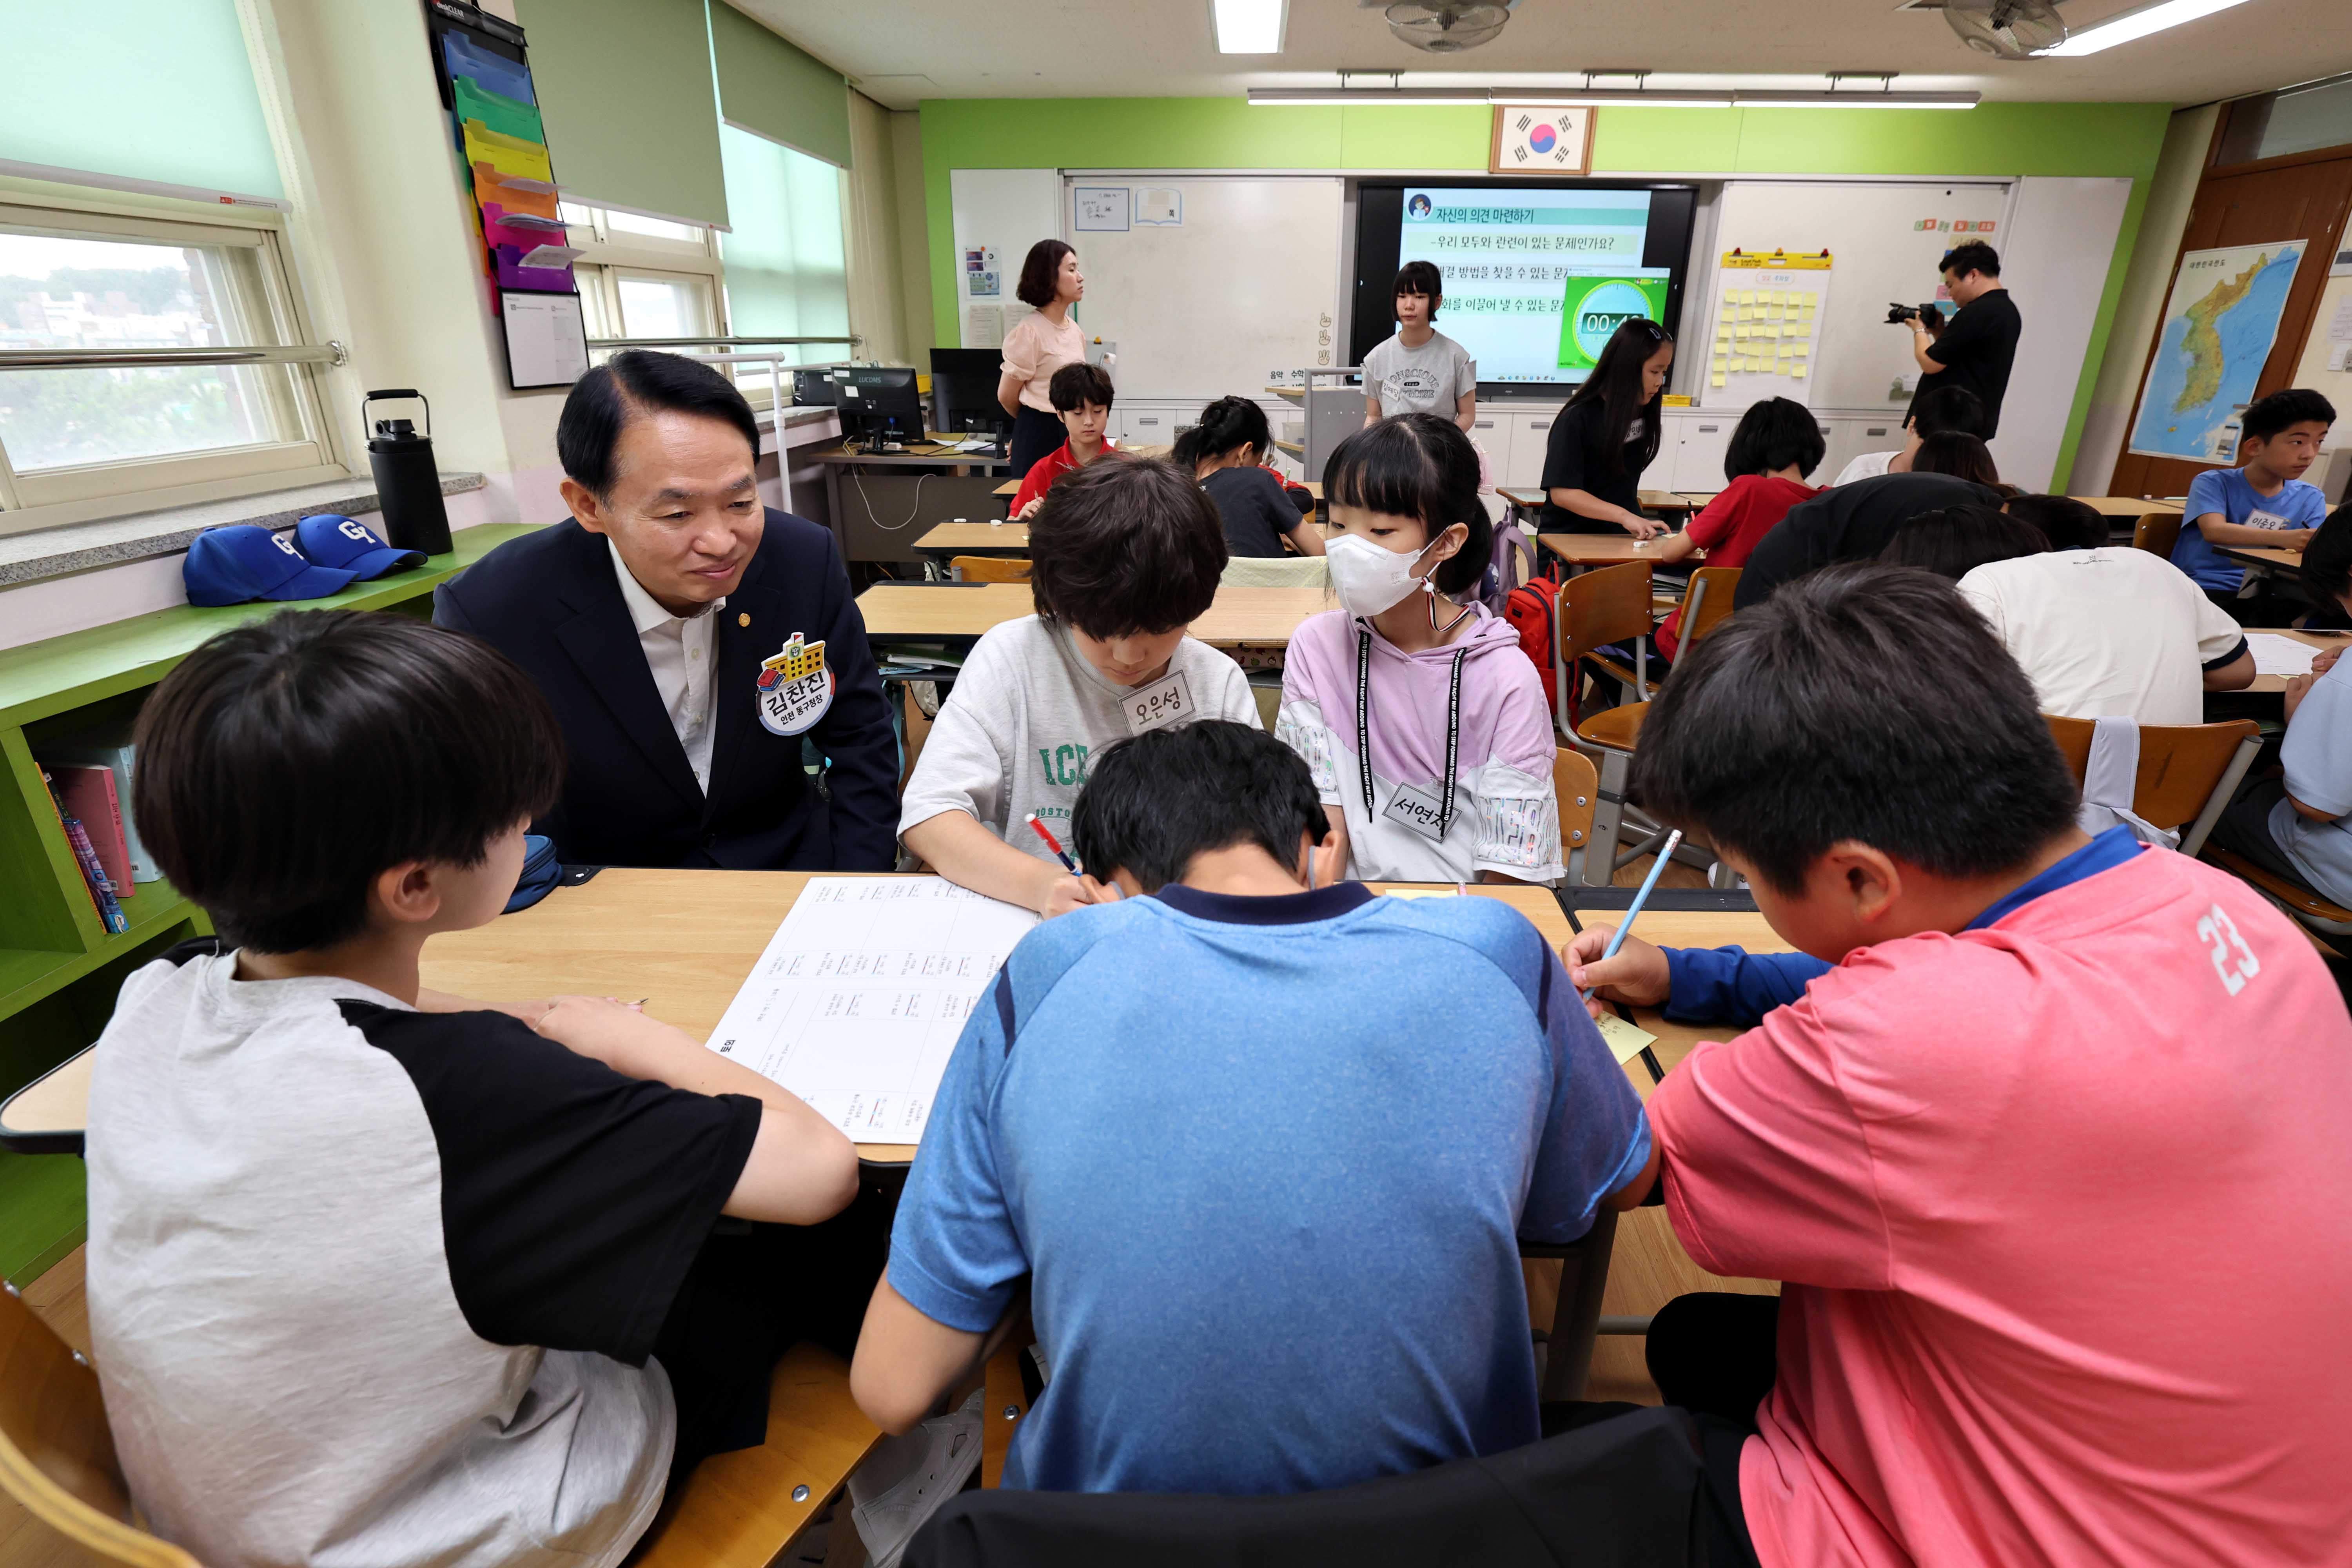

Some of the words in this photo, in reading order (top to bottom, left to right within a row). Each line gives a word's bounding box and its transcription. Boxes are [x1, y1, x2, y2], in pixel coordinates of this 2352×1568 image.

[1436, 208, 1466, 223] 자신의
[1470, 209, 1490, 223] 의견
[1493, 209, 1534, 223] 마련하기
[1431, 236, 1457, 249] -우리
[1461, 236, 1490, 249] 모두와
[1495, 236, 1528, 249] 관련이
[1532, 236, 1551, 250] 있는
[1555, 237, 1615, 250] 문제인가요?
[1459, 266, 1489, 279] 방법을
[1493, 266, 1513, 279] 찾을
[1517, 267, 1526, 279] 수
[1530, 267, 1550, 280] 있는
[1442, 298, 1462, 311] 화를
[1466, 298, 1496, 312] 이끌어
[1500, 298, 1511, 312] 낼
[1514, 299, 1524, 311] 수
[1527, 299, 1546, 312] 있는
[1587, 315, 1640, 332] 00:4
[1270, 371, 1283, 379] 음악
[1291, 369, 1304, 378] 수학
[1389, 368, 1439, 389] ONSCIOUS
[766, 671, 825, 717] 김찬진
[780, 712, 795, 725] 인천
[796, 694, 823, 716] 동구청장
[1136, 686, 1181, 726] 오은성
[1039, 743, 1105, 786] ICE
[1036, 807, 1073, 818] BOSTO
[2197, 903, 2261, 997] 23
[720, 1040, 737, 1053] 토의
